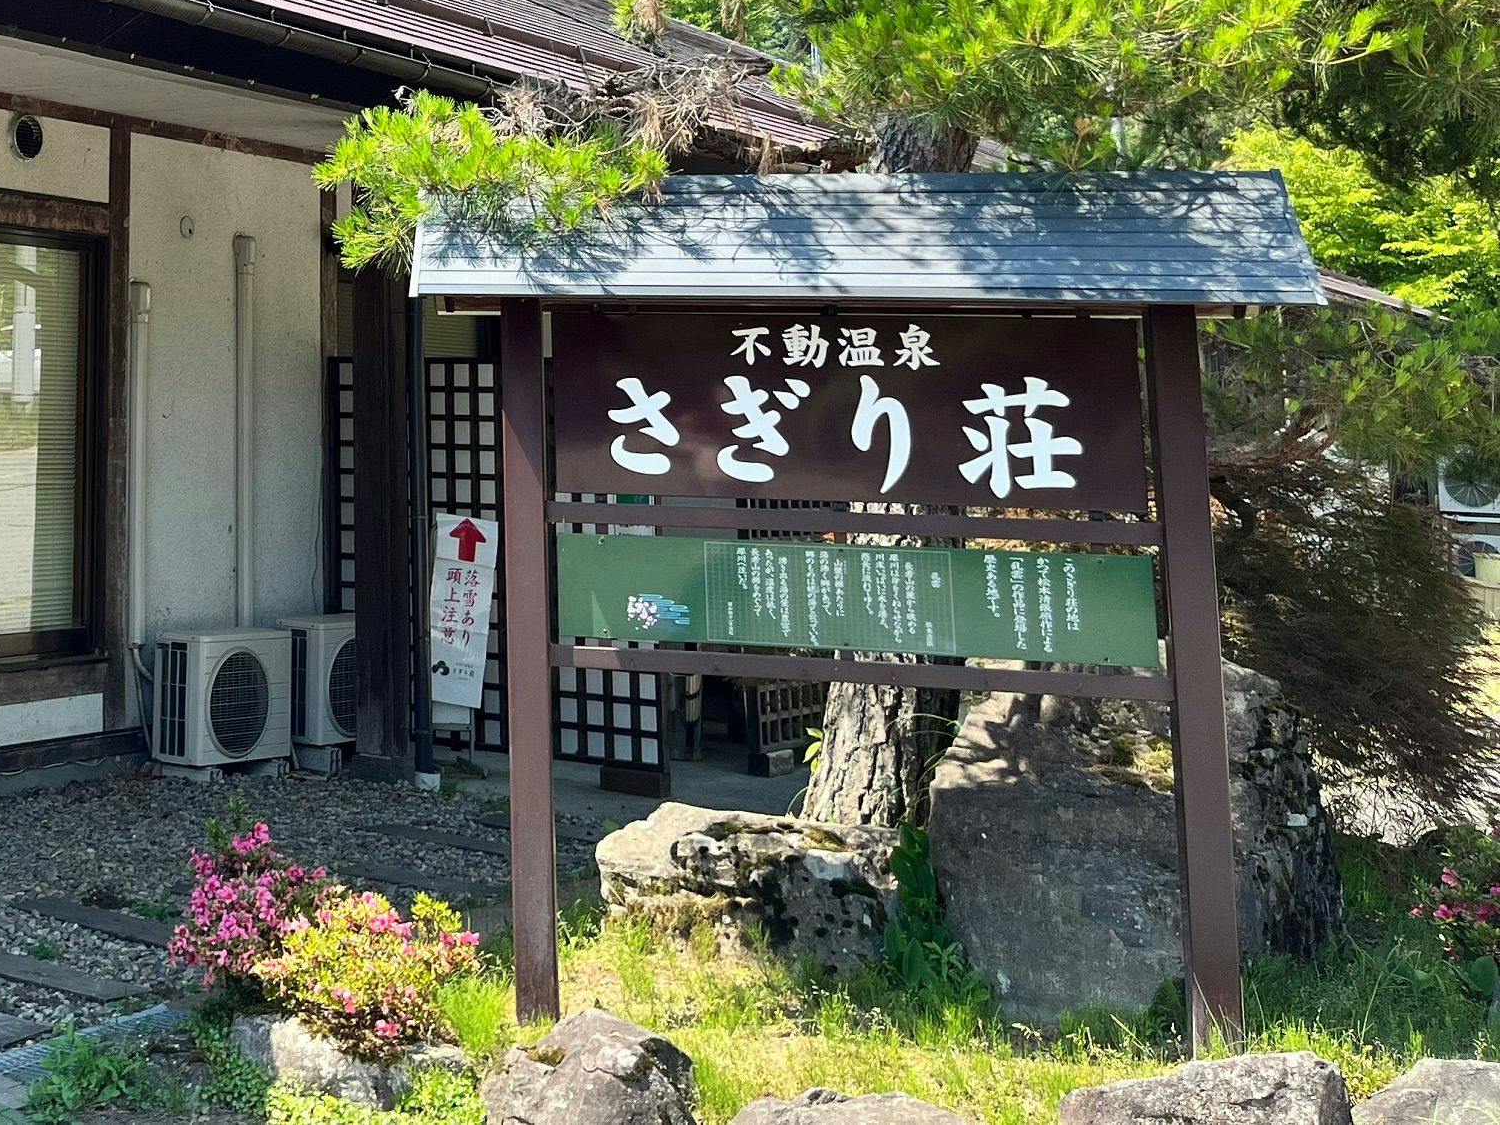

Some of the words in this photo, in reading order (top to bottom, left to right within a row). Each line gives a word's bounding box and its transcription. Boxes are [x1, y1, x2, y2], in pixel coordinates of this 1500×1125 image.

[730, 323, 941, 371] 不動温泉
[607, 374, 1083, 500] さぎり荘
[440, 567, 463, 646] 頭上注意
[461, 568, 480, 647] 落雪あり
[983, 554, 1001, 618] 歴史ある地です。
[1062, 557, 1080, 631] このさぎり荘の地は
